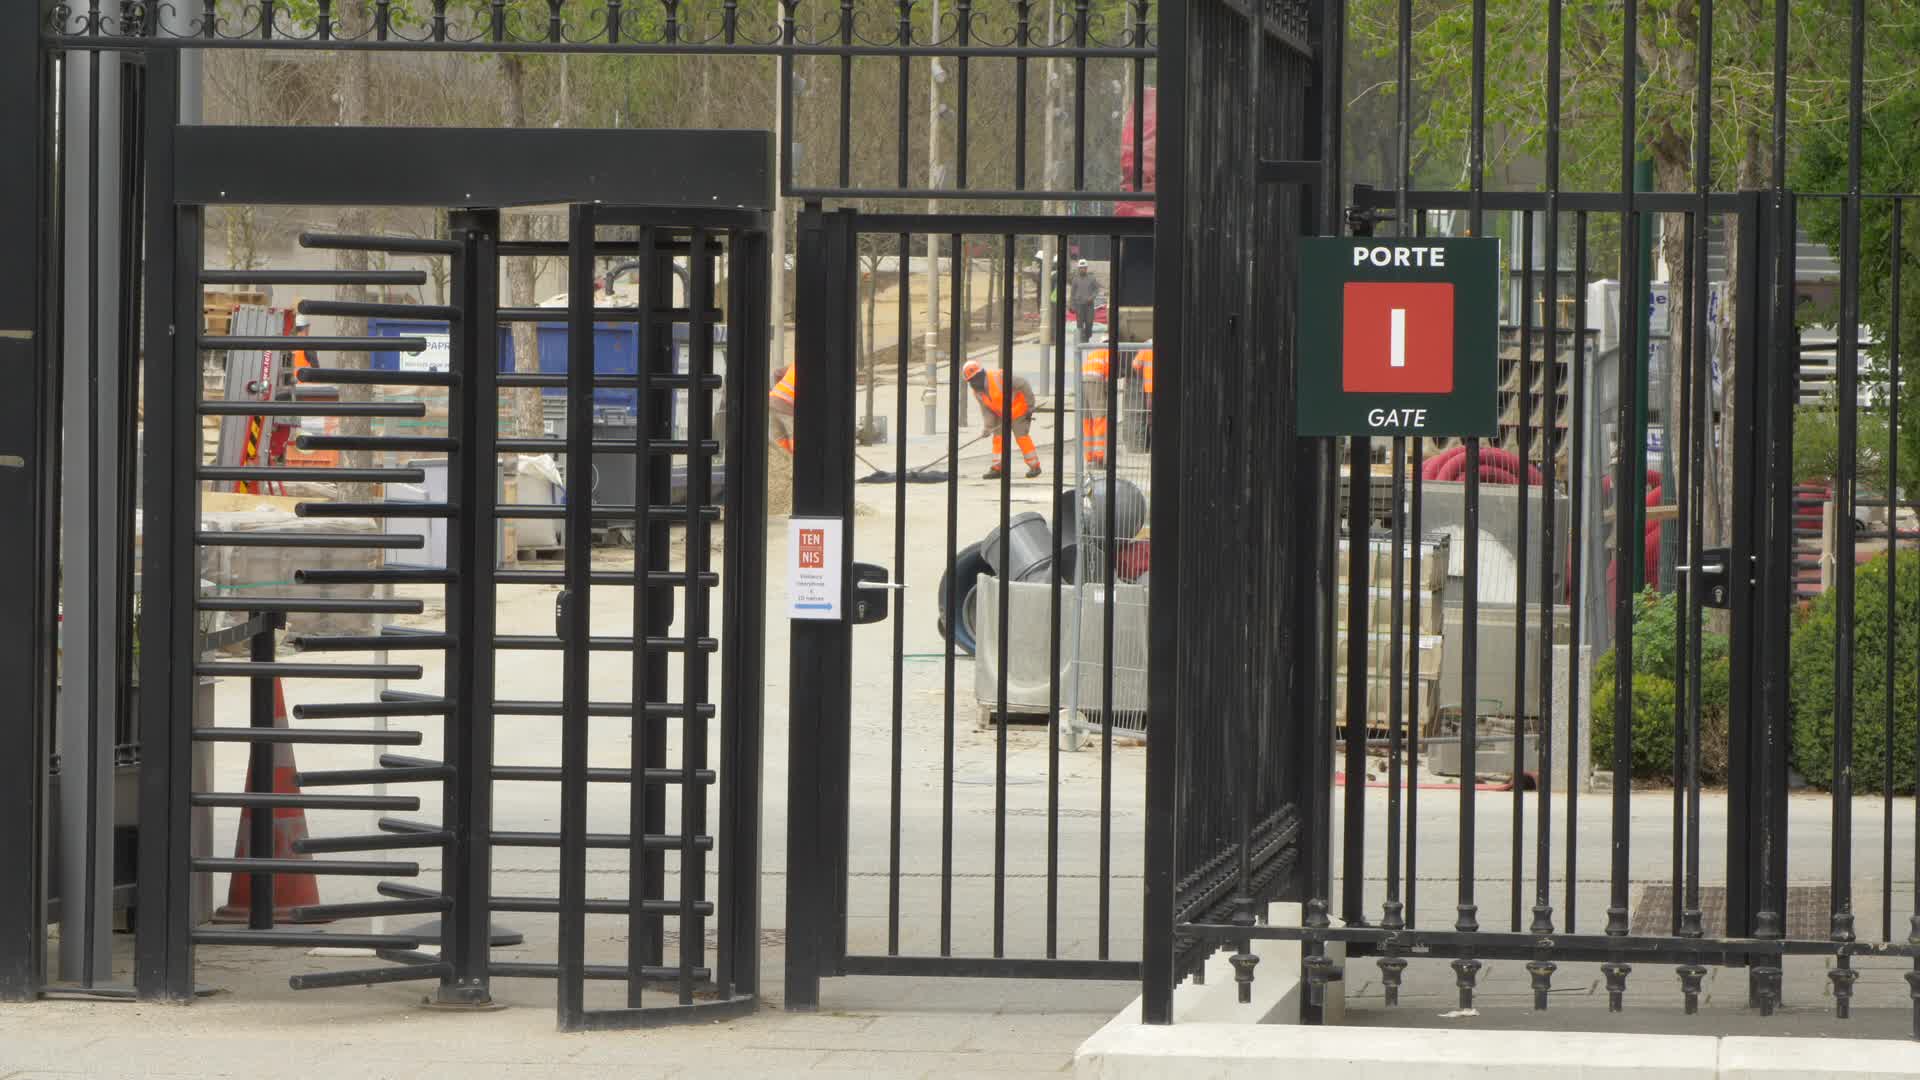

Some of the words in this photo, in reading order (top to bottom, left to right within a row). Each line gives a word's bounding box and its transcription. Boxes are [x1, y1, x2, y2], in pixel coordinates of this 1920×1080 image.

[1353, 246, 1445, 267] PORTE
[1367, 408, 1427, 427] GATE
[802, 534, 820, 545] TEN
[802, 552, 820, 563] NIS
